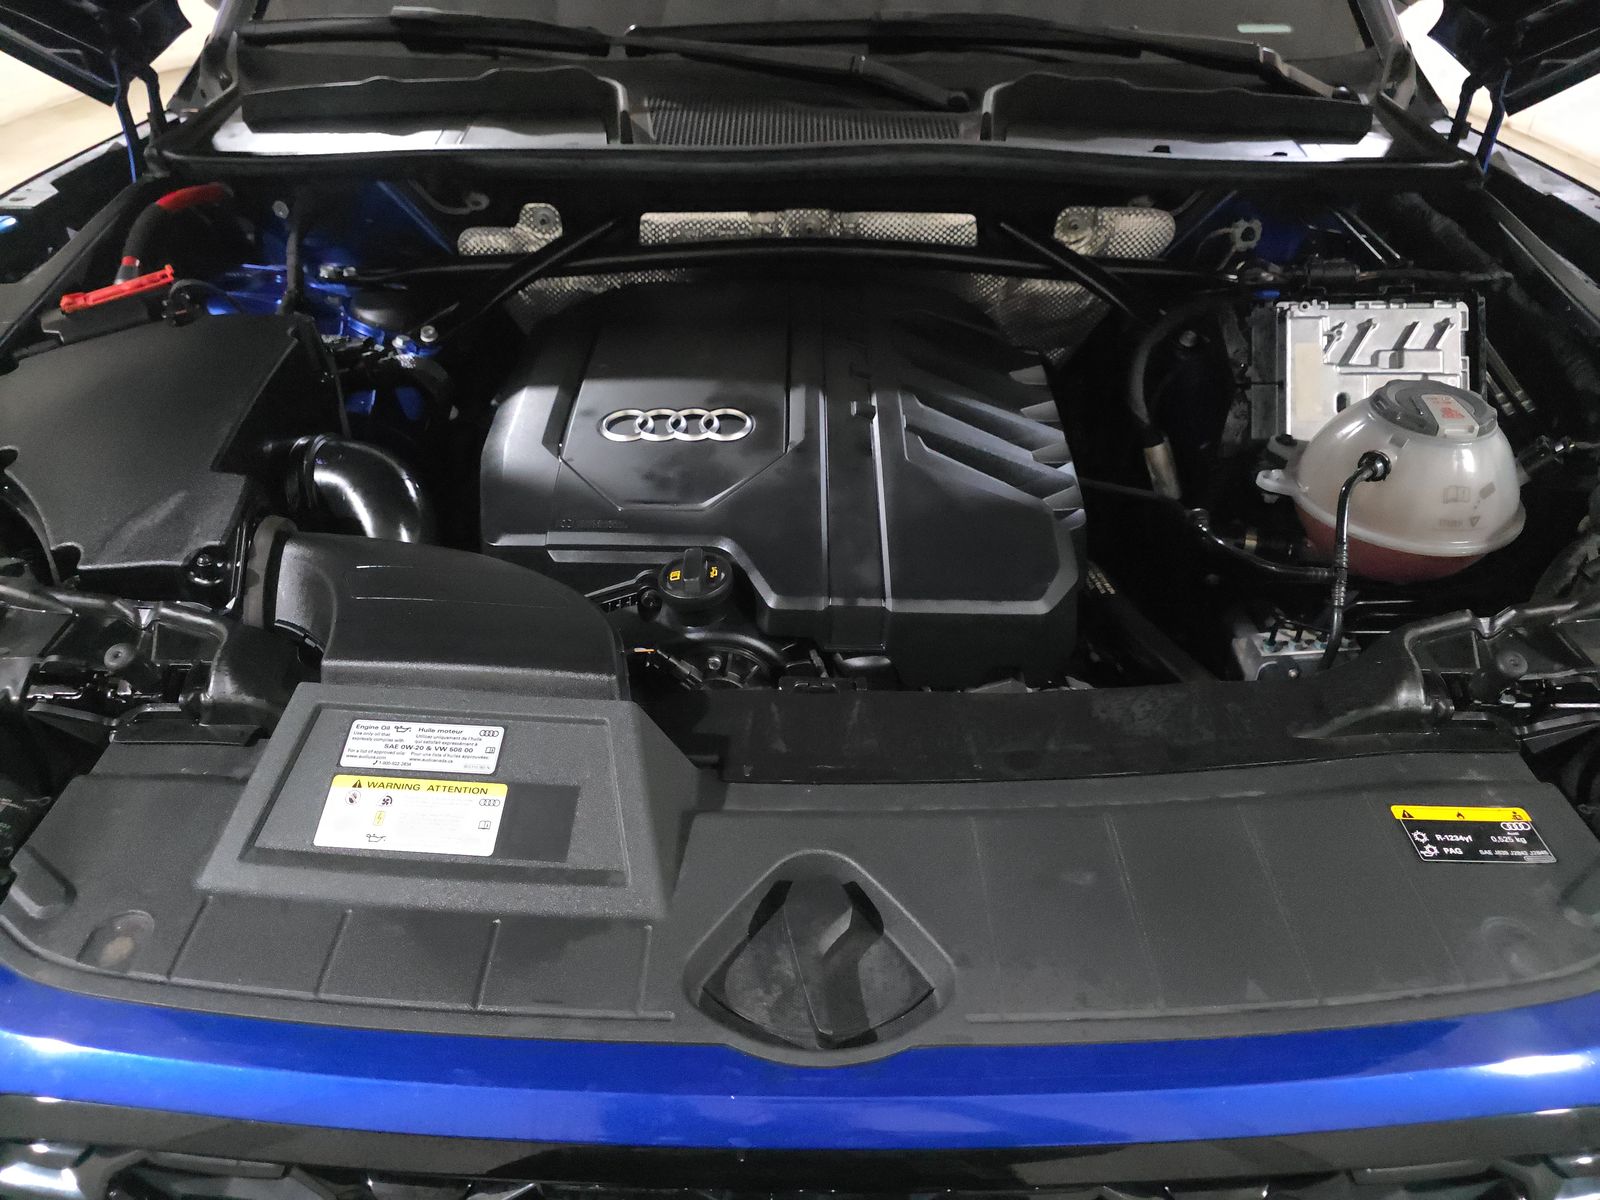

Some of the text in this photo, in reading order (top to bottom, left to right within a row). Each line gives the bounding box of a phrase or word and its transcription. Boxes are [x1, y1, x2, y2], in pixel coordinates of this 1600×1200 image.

[367, 781, 489, 795] WARNING ATTENTION
[1435, 834, 1473, 843] R-1234yf
[1515, 836, 1527, 844] kg
[1443, 847, 1463, 855] PAG
